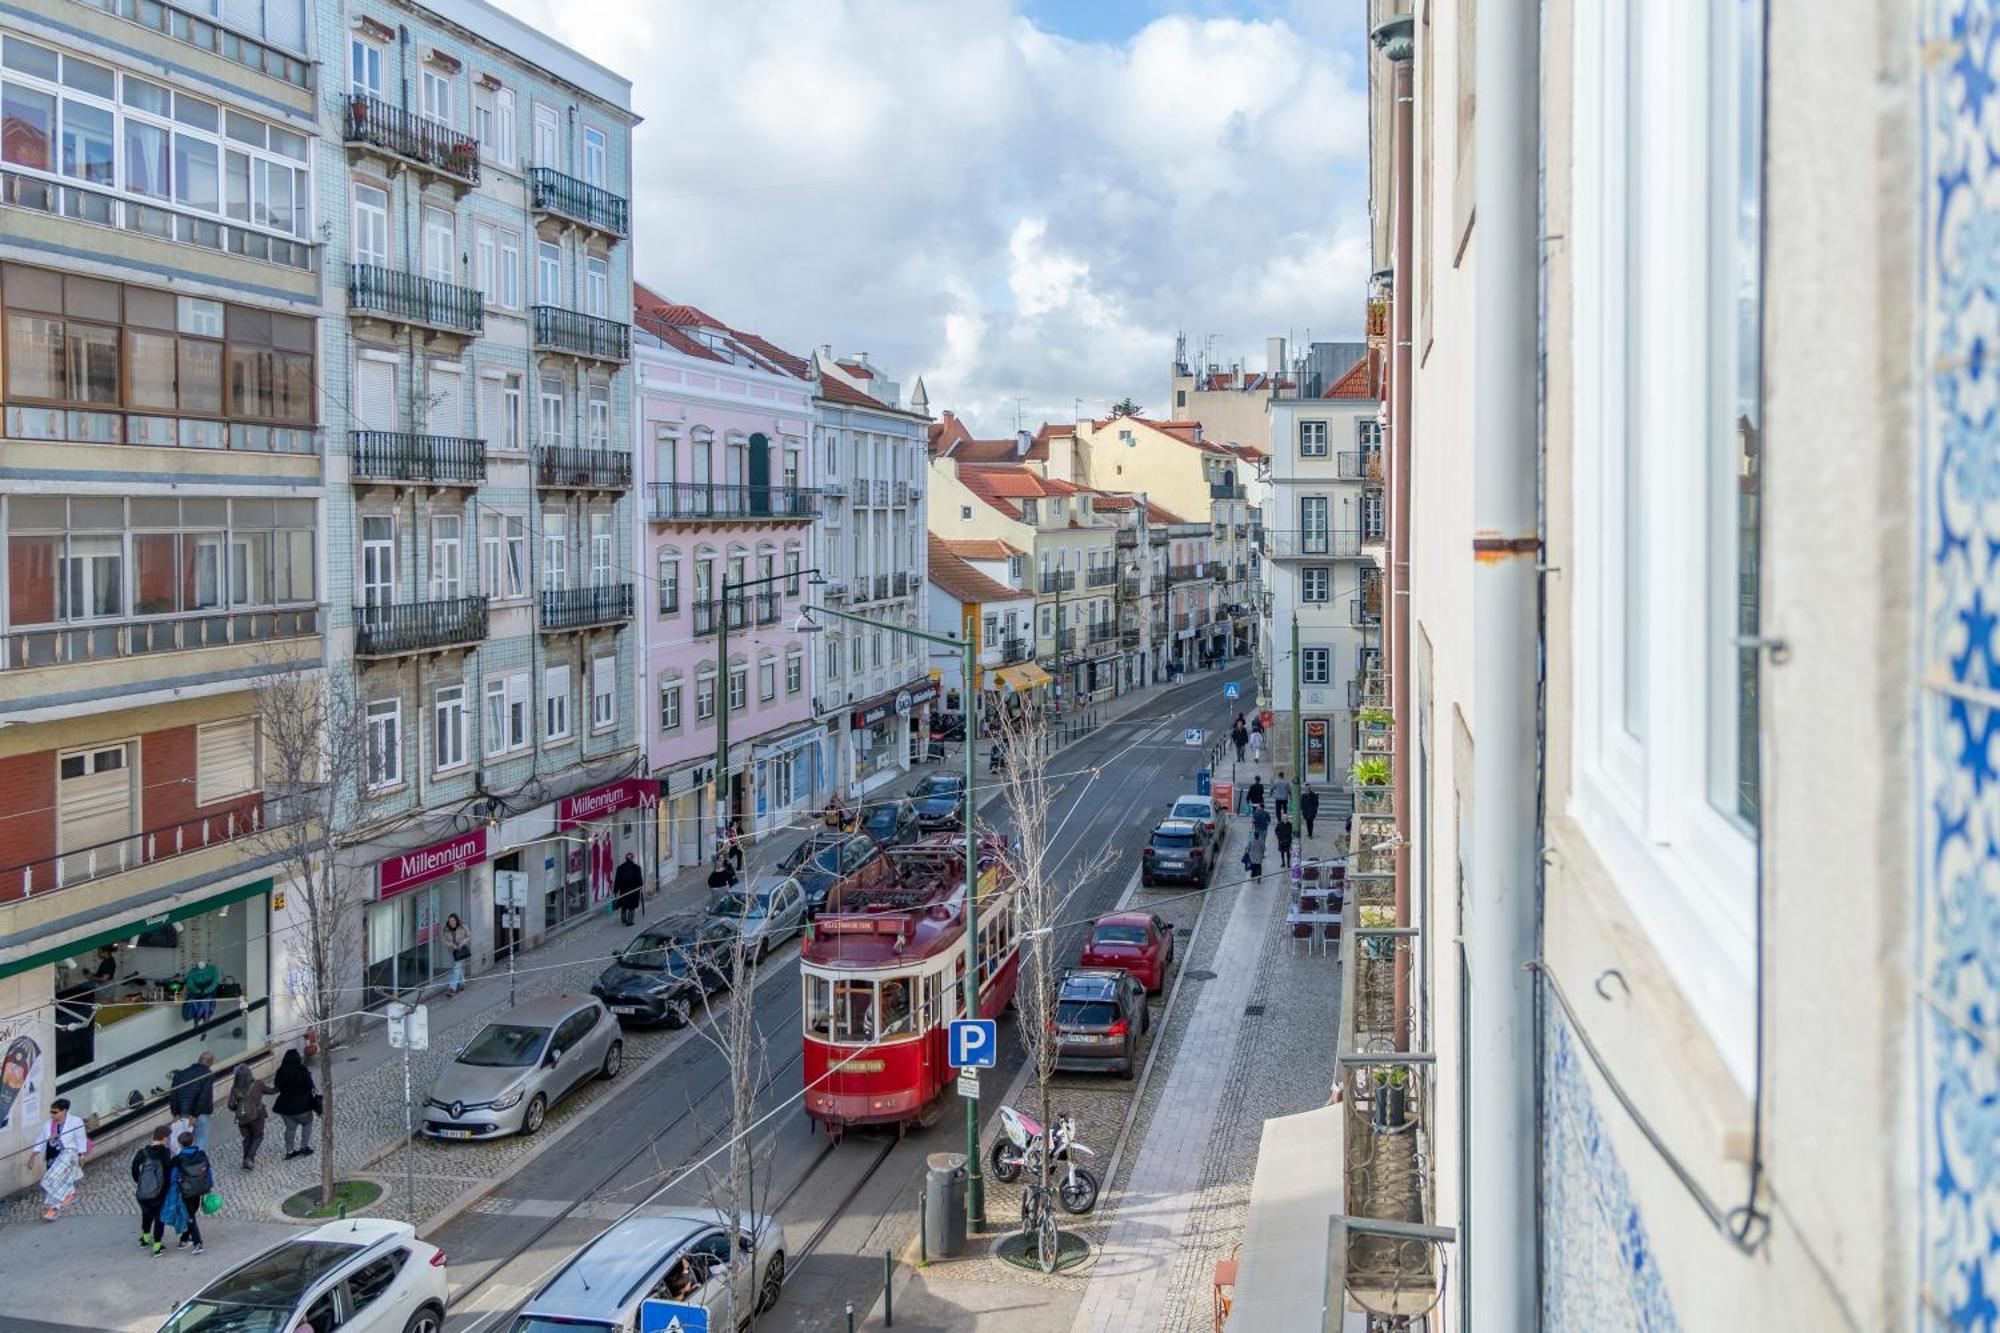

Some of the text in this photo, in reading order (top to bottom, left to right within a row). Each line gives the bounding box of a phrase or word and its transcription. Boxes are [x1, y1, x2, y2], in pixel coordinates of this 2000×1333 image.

[692, 767, 704, 789] M
[570, 788, 624, 817] Millennium
[401, 840, 476, 879] Millennium
[960, 1025, 986, 1062] P
